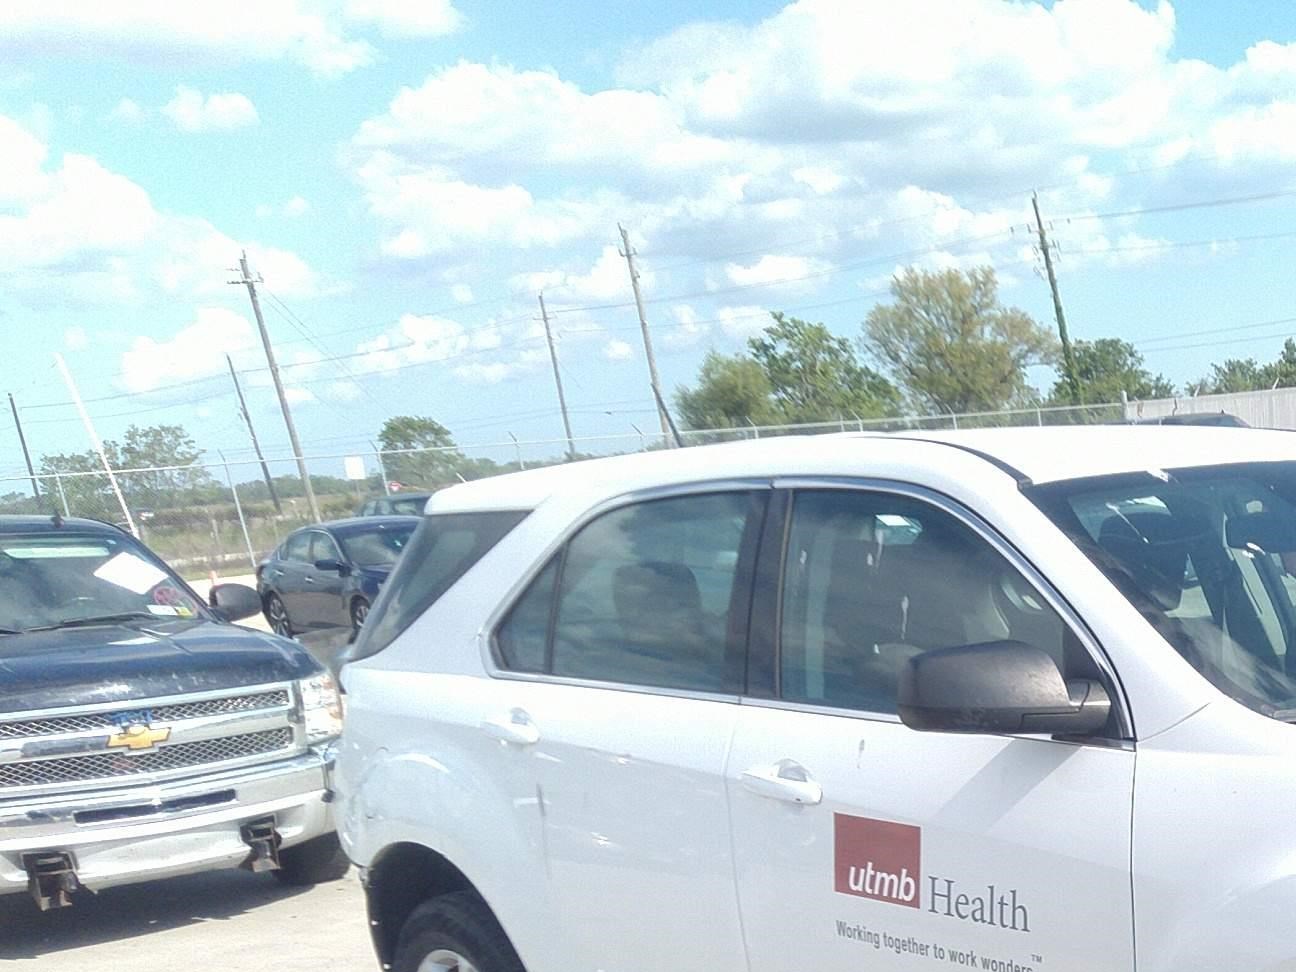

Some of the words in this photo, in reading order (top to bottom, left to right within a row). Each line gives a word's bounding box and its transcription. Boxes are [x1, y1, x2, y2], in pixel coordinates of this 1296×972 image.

[848, 862, 916, 902] utmb
[928, 876, 1031, 932] Health
[835, 920, 880, 949] Working
[883, 932, 930, 957] together
[933, 943, 945, 960] to
[948, 949, 978, 968] work
